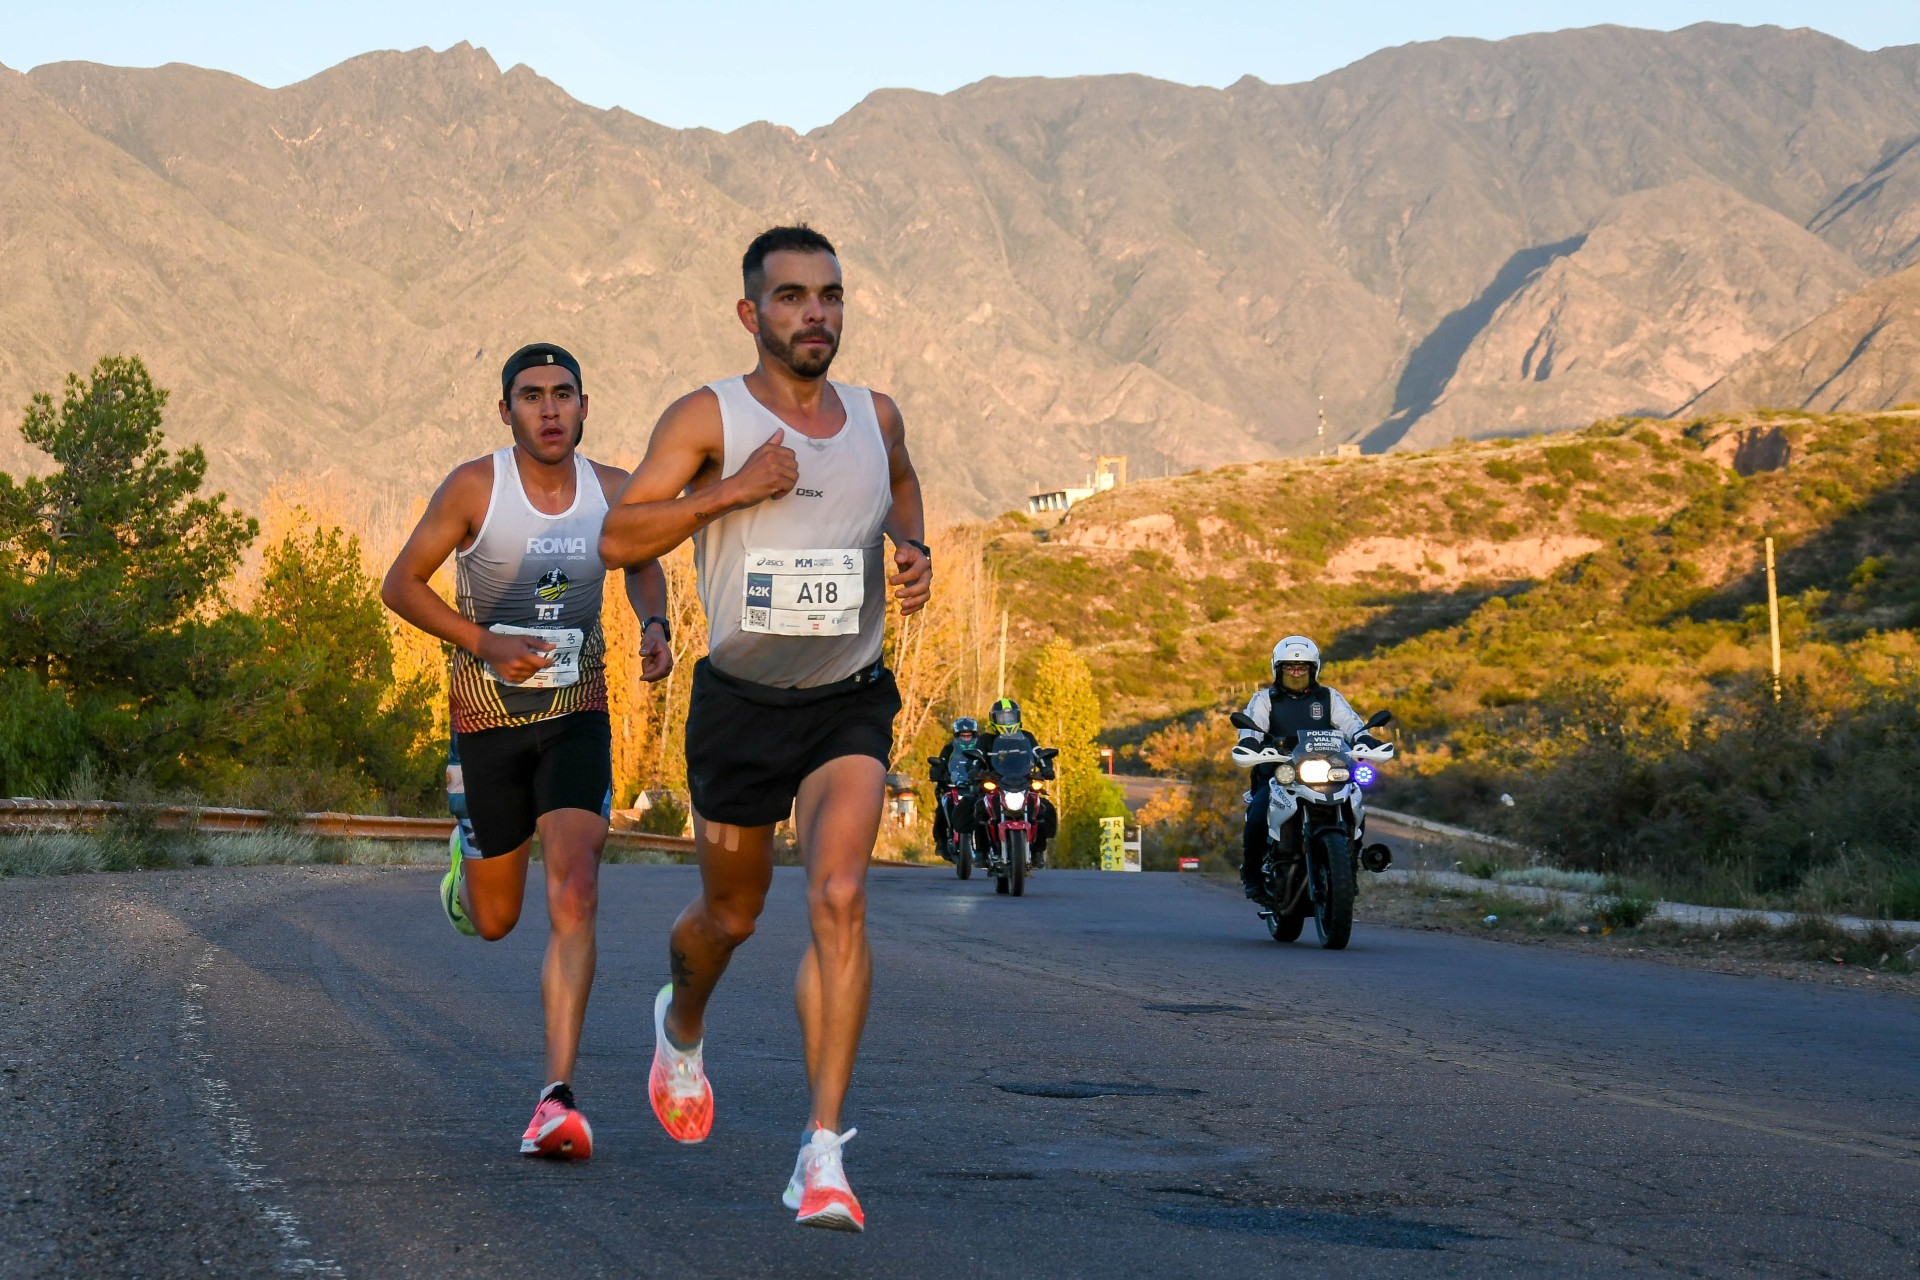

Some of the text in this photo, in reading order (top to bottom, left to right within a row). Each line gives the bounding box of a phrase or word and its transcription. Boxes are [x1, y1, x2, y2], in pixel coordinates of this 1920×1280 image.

[526, 537, 586, 554] ROMA
[748, 586, 770, 597] 42K
[797, 582, 838, 604] A18
